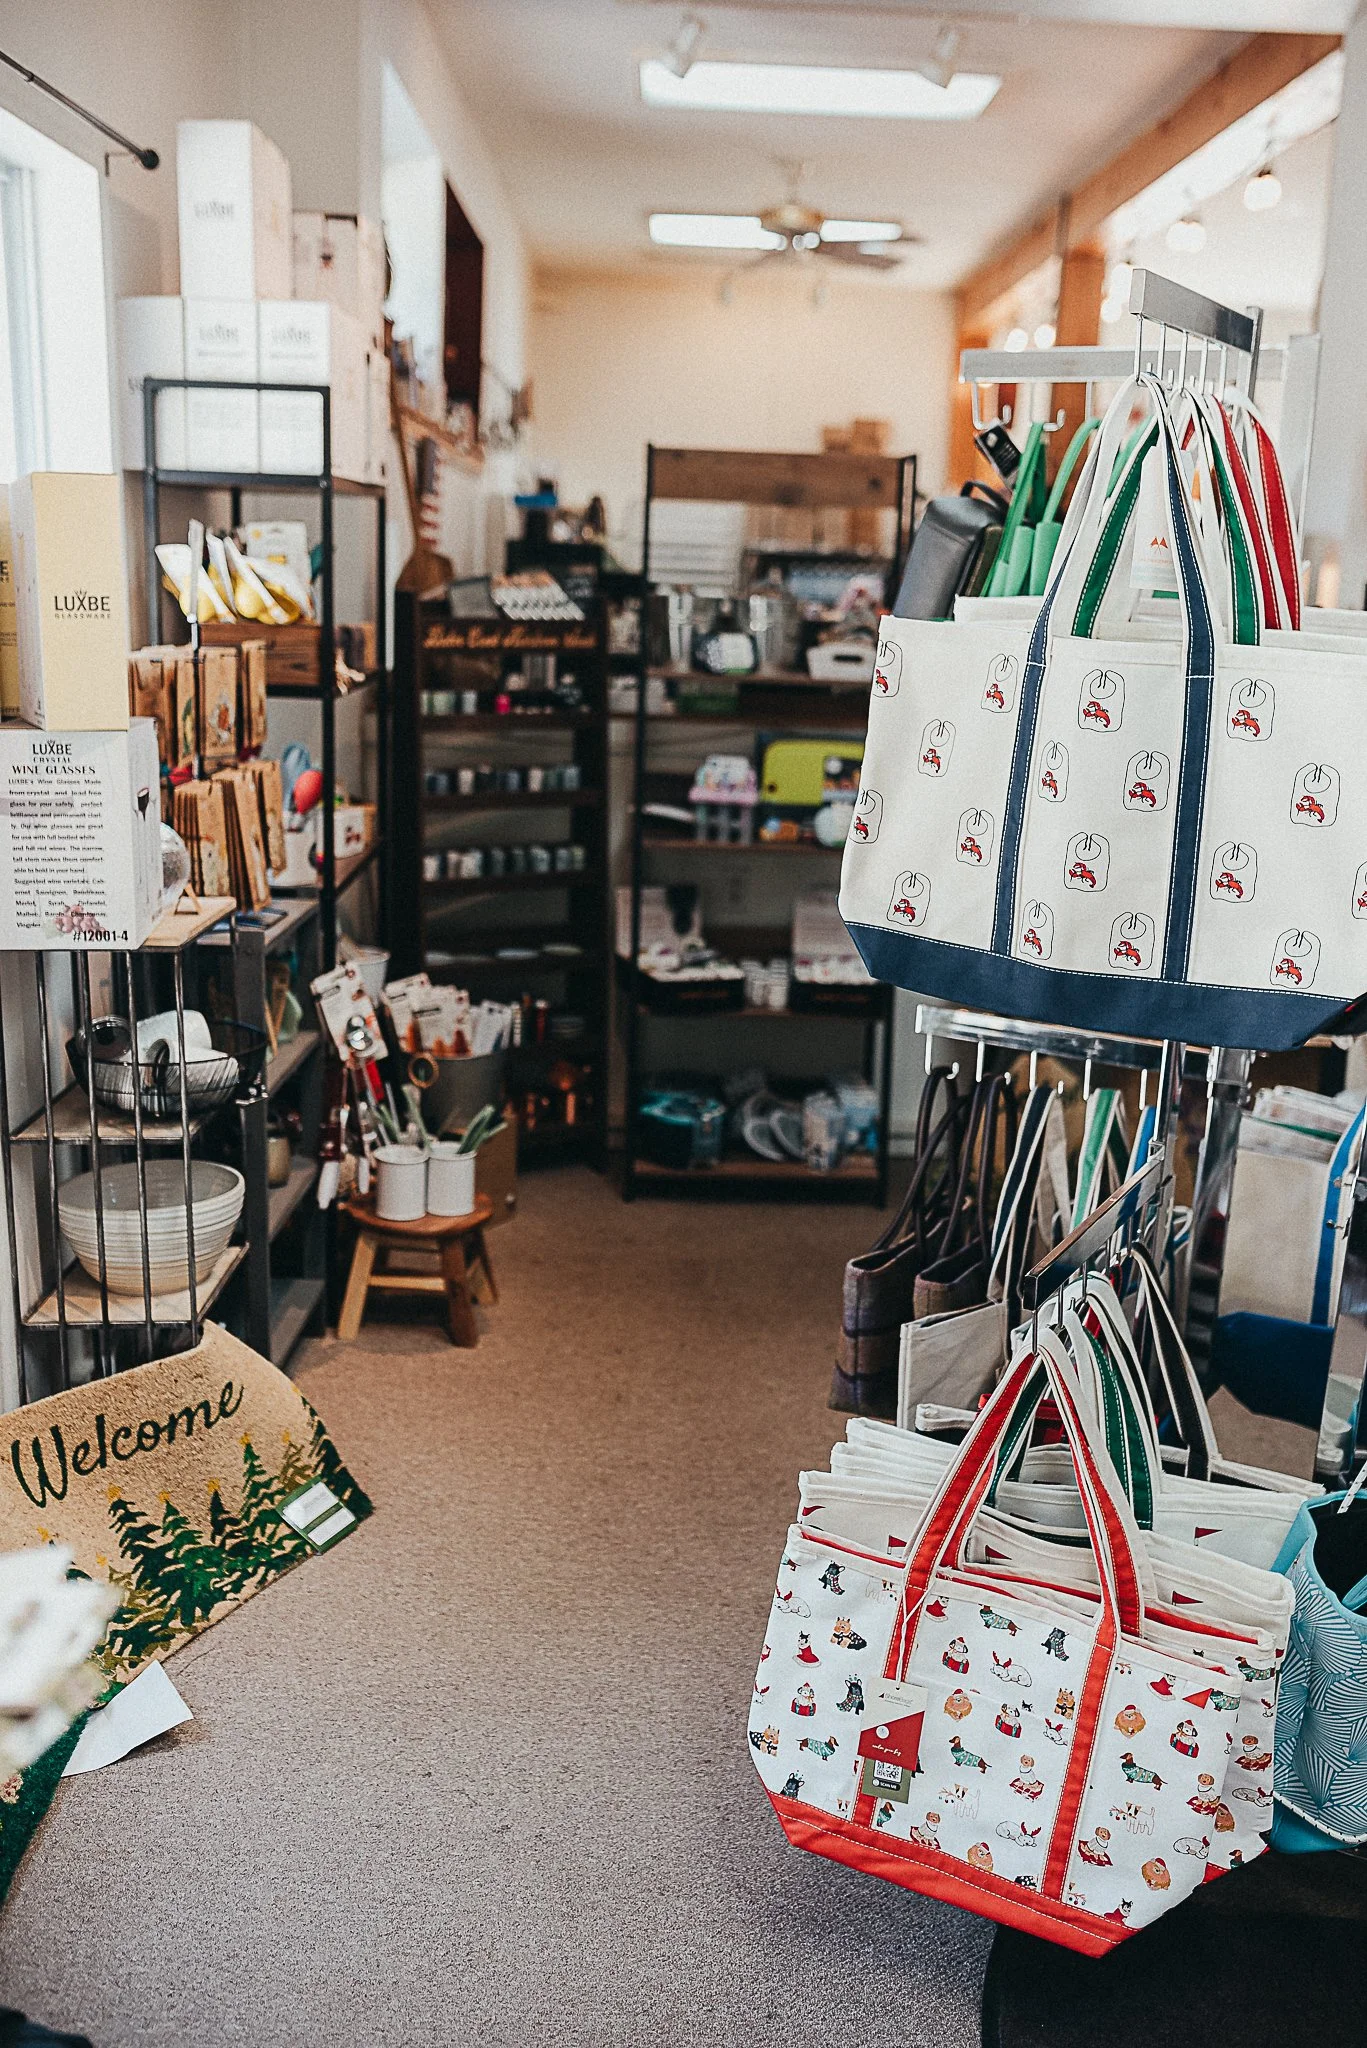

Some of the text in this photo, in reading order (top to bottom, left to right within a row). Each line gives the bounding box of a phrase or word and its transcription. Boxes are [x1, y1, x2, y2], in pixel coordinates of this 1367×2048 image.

[54, 590, 111, 611] LUXBE
[32, 741, 72, 756] LUXBE
[12, 766, 96, 775] WINE GLASSES
[73, 930, 128, 942] #12001-4
[11, 1381, 244, 1509] Welcome
